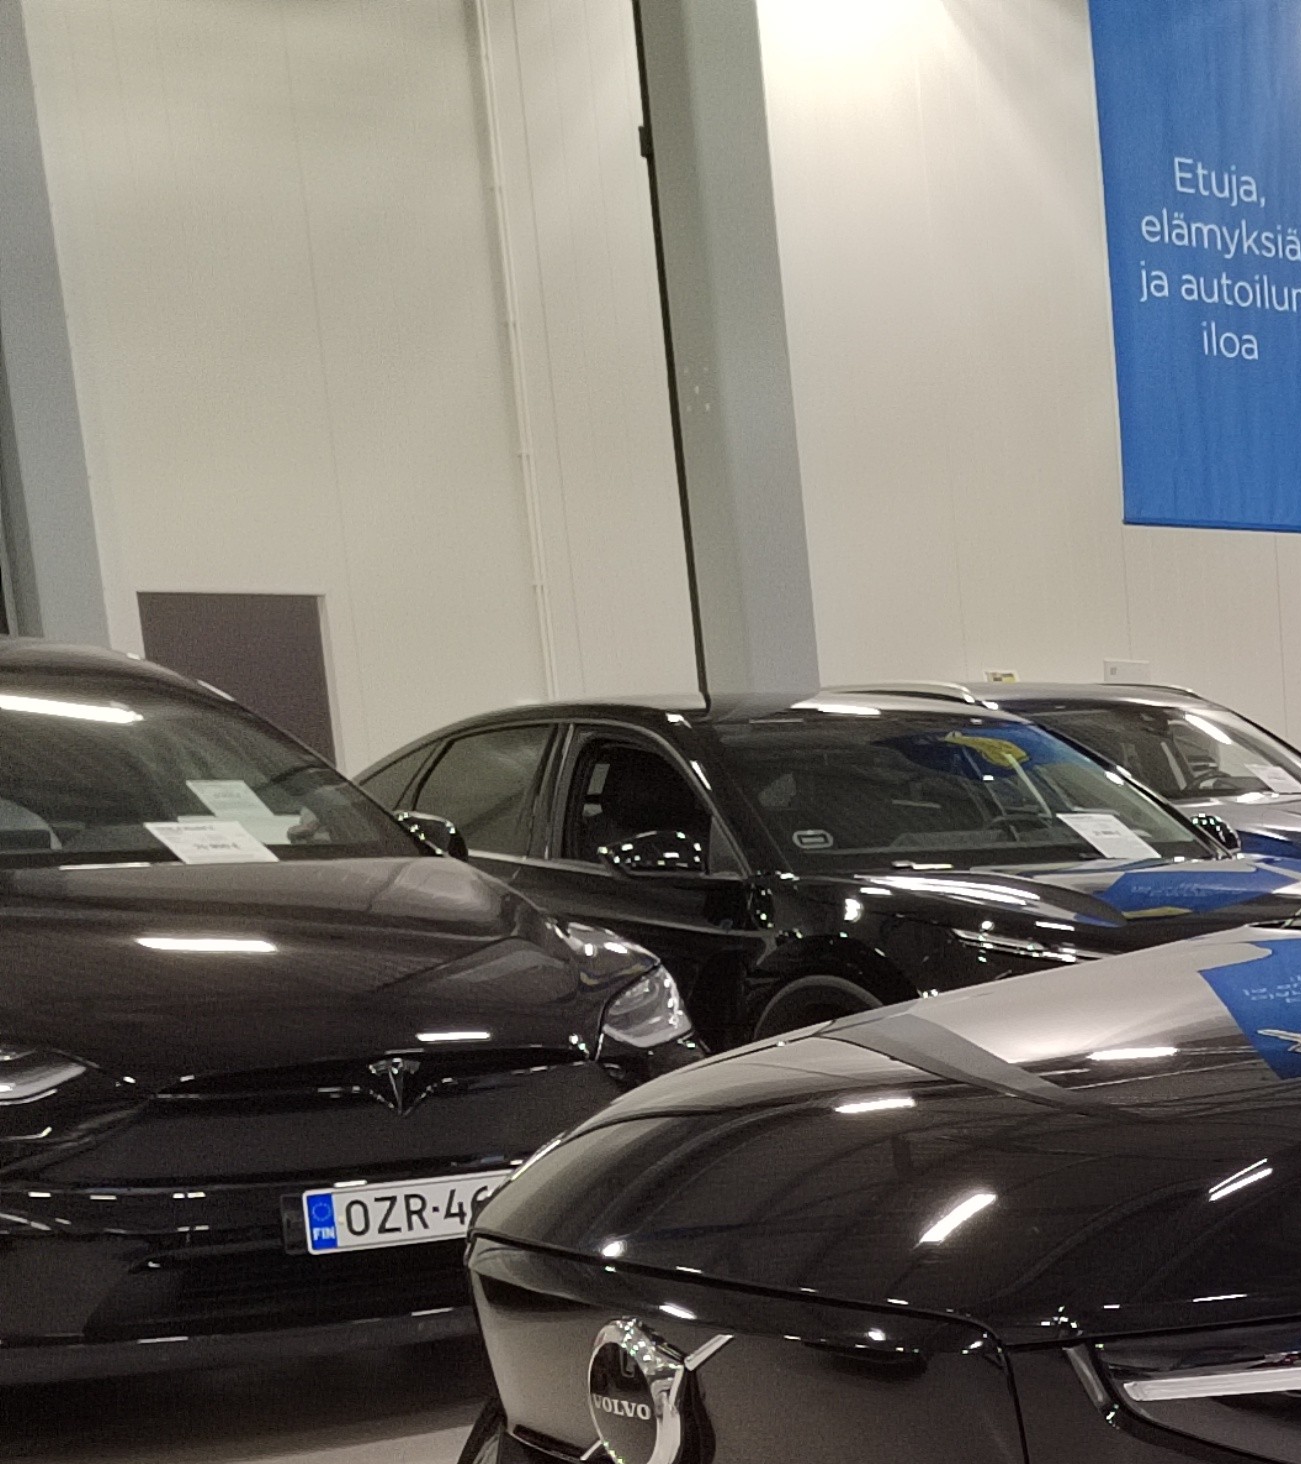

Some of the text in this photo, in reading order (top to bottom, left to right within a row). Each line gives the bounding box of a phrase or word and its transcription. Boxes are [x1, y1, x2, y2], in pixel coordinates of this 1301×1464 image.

[1173, 156, 1266, 208] Etuja,
[1138, 260, 1169, 303] ja
[1201, 320, 1259, 361] iloa
[592, 1392, 652, 1420] VOLVO
